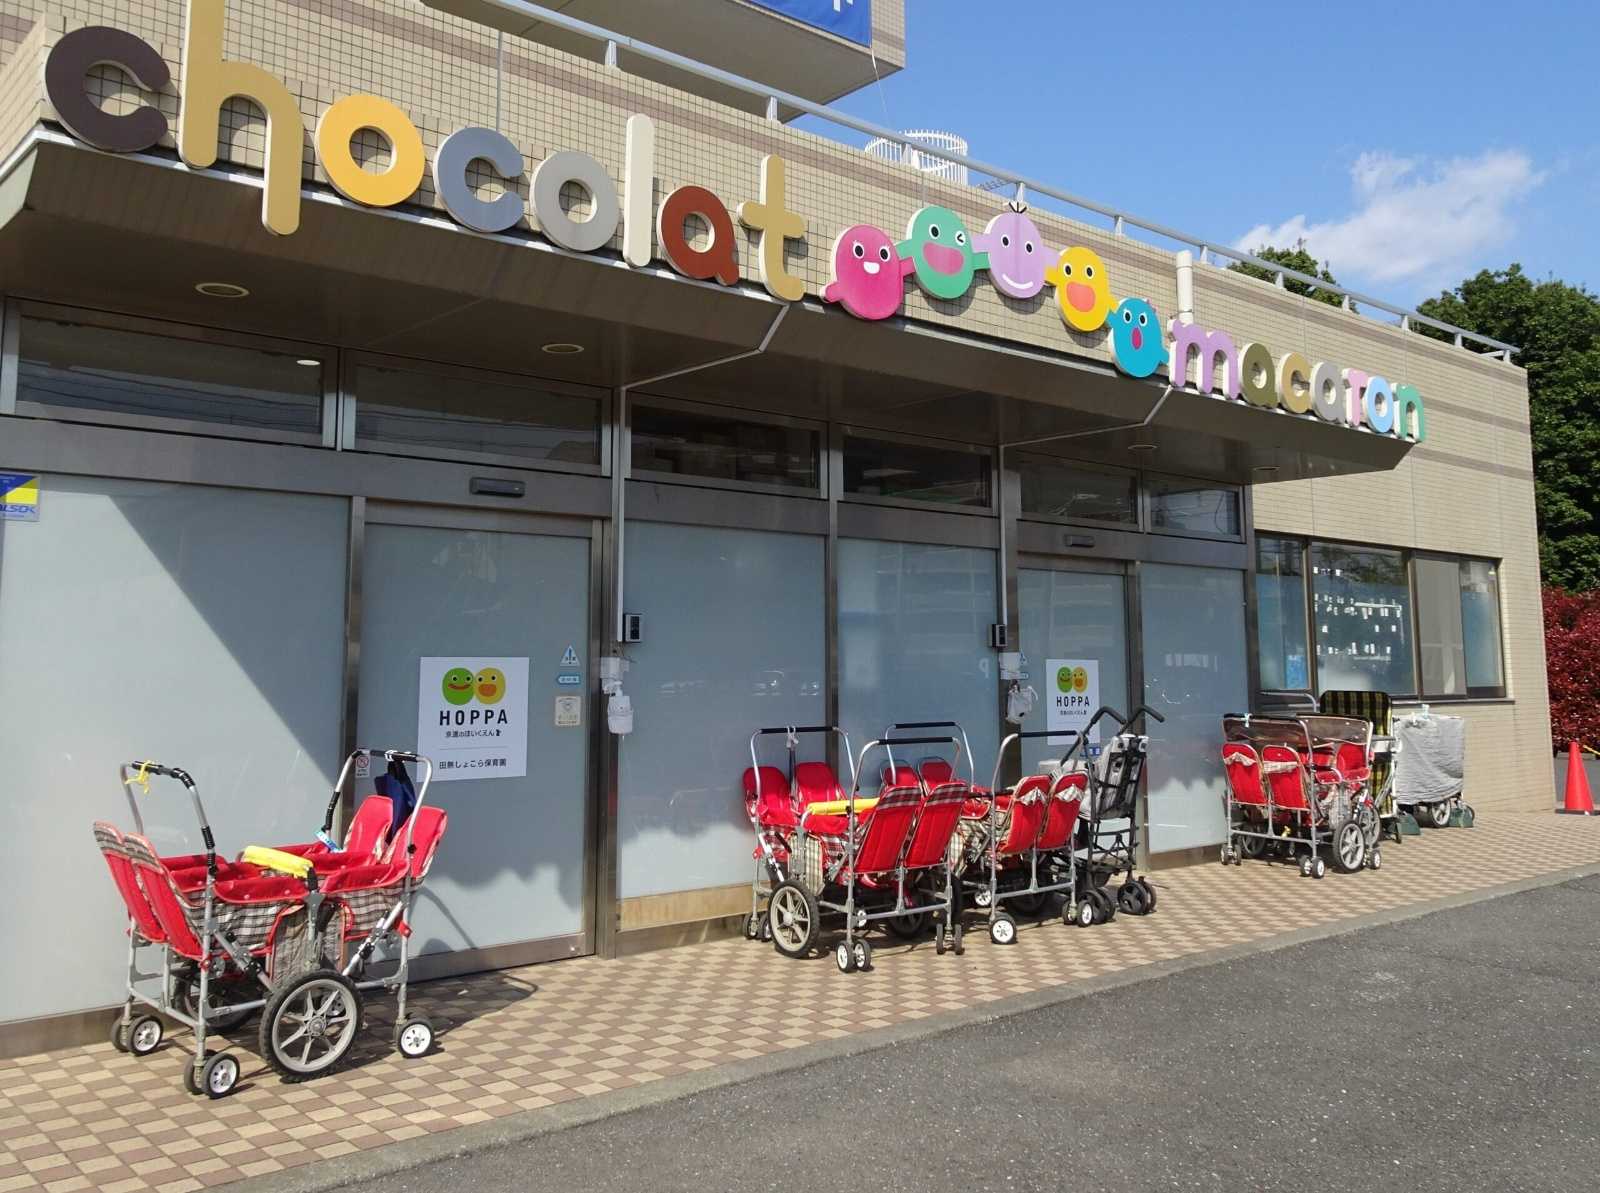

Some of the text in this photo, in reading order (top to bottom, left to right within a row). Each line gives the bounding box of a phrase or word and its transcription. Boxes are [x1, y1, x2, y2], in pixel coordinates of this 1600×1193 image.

[43, 0, 807, 302] chocolat
[1168, 318, 1426, 443] macaron
[439, 709, 508, 726] HOPPA
[1056, 696, 1090, 708] HOPPA
